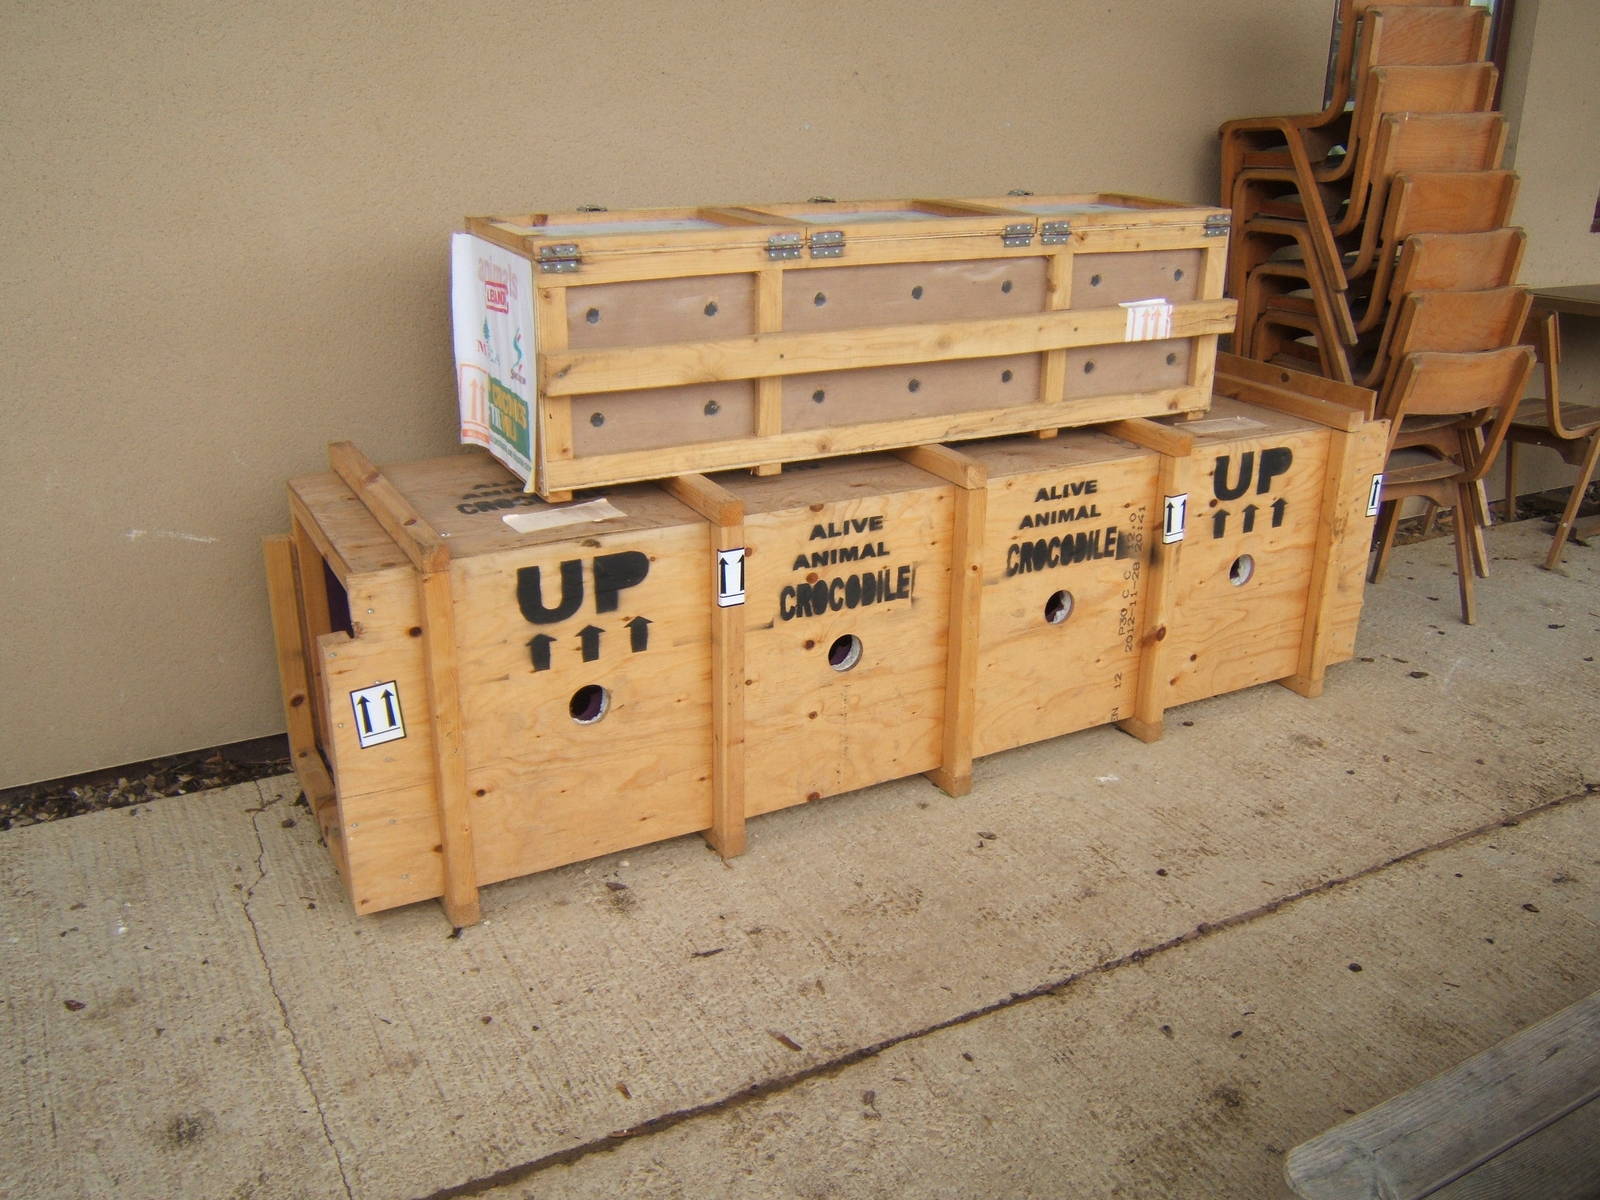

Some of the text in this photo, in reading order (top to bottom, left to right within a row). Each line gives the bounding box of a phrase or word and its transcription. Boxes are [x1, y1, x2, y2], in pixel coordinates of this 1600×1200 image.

[1213, 447, 1294, 502] UP
[1035, 480, 1098, 502] ALIVE
[809, 515, 884, 541] ALIVE
[1019, 504, 1102, 530] ANIMAL
[792, 541, 890, 571] ANIMAL
[1006, 526, 1117, 577] CROCODILE
[517, 550, 650, 625] UP
